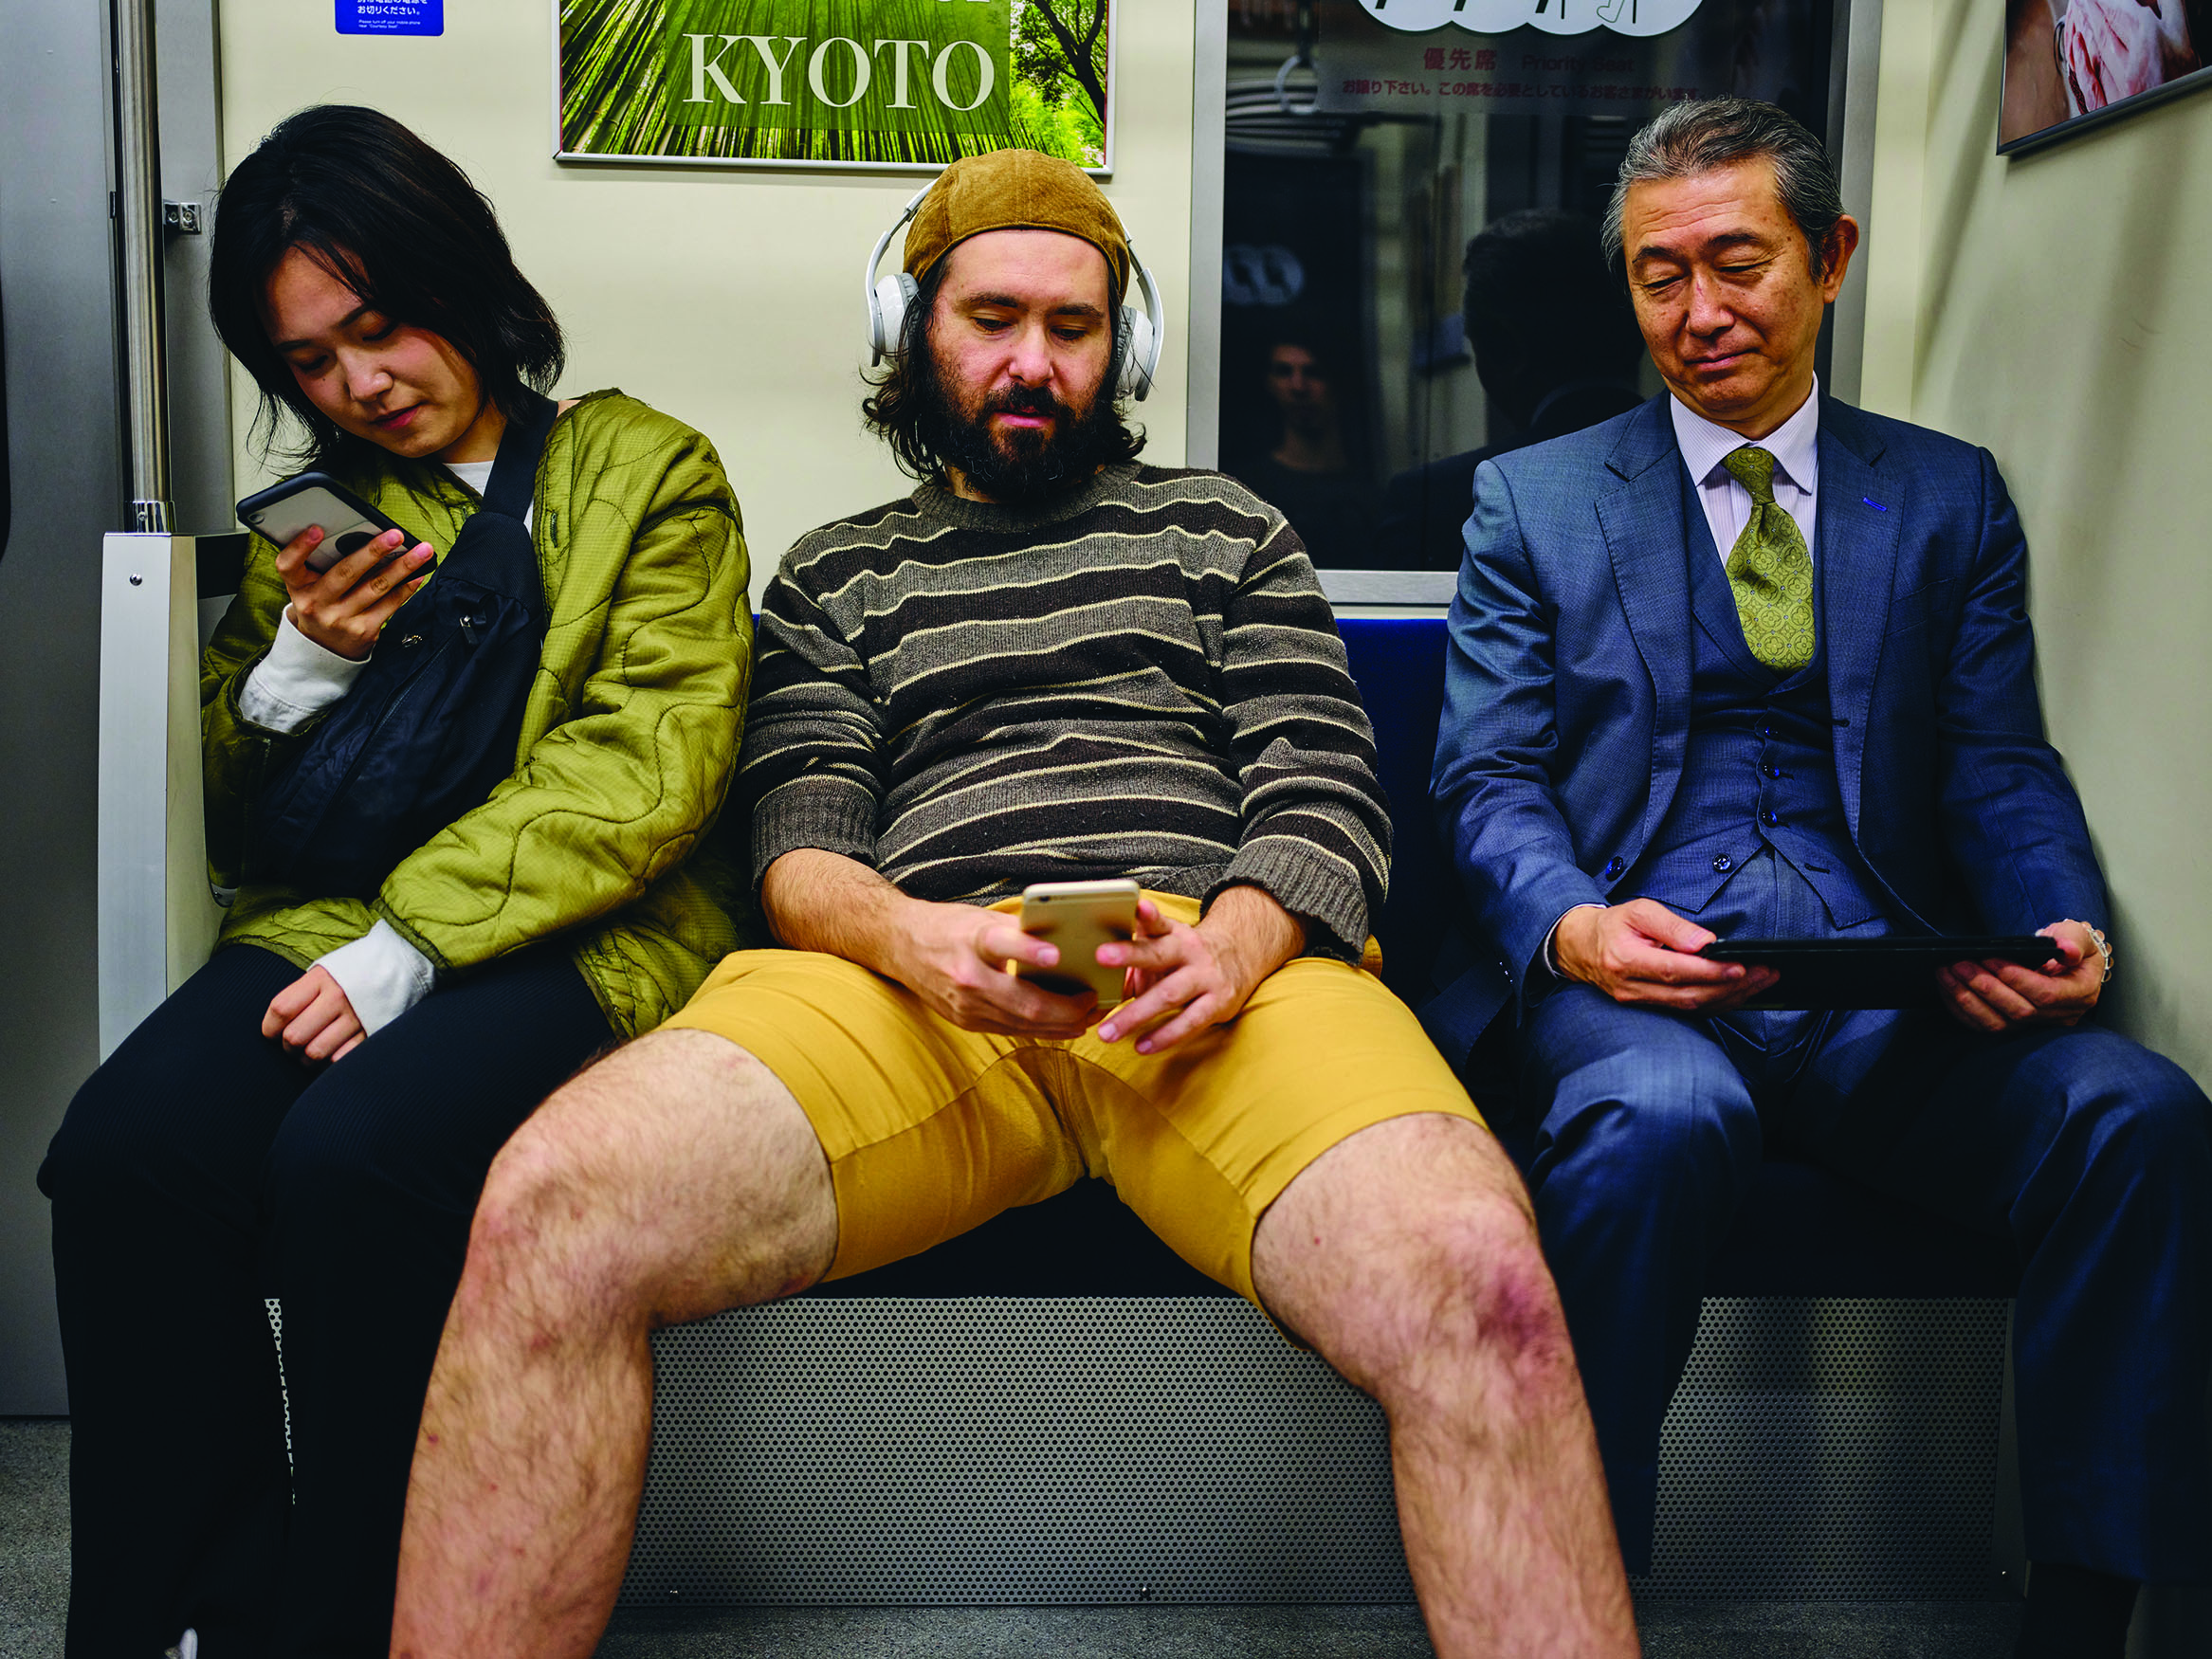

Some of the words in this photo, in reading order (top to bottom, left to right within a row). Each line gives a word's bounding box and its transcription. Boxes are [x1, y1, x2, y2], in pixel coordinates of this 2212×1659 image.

[357, 5, 420, 15] お切りください。
[1423, 47, 1497, 70] 優先席
[1522, 54, 1586, 74] Priority
[1593, 56, 1635, 73] Seat
[683, 33, 995, 111] KYOTO
